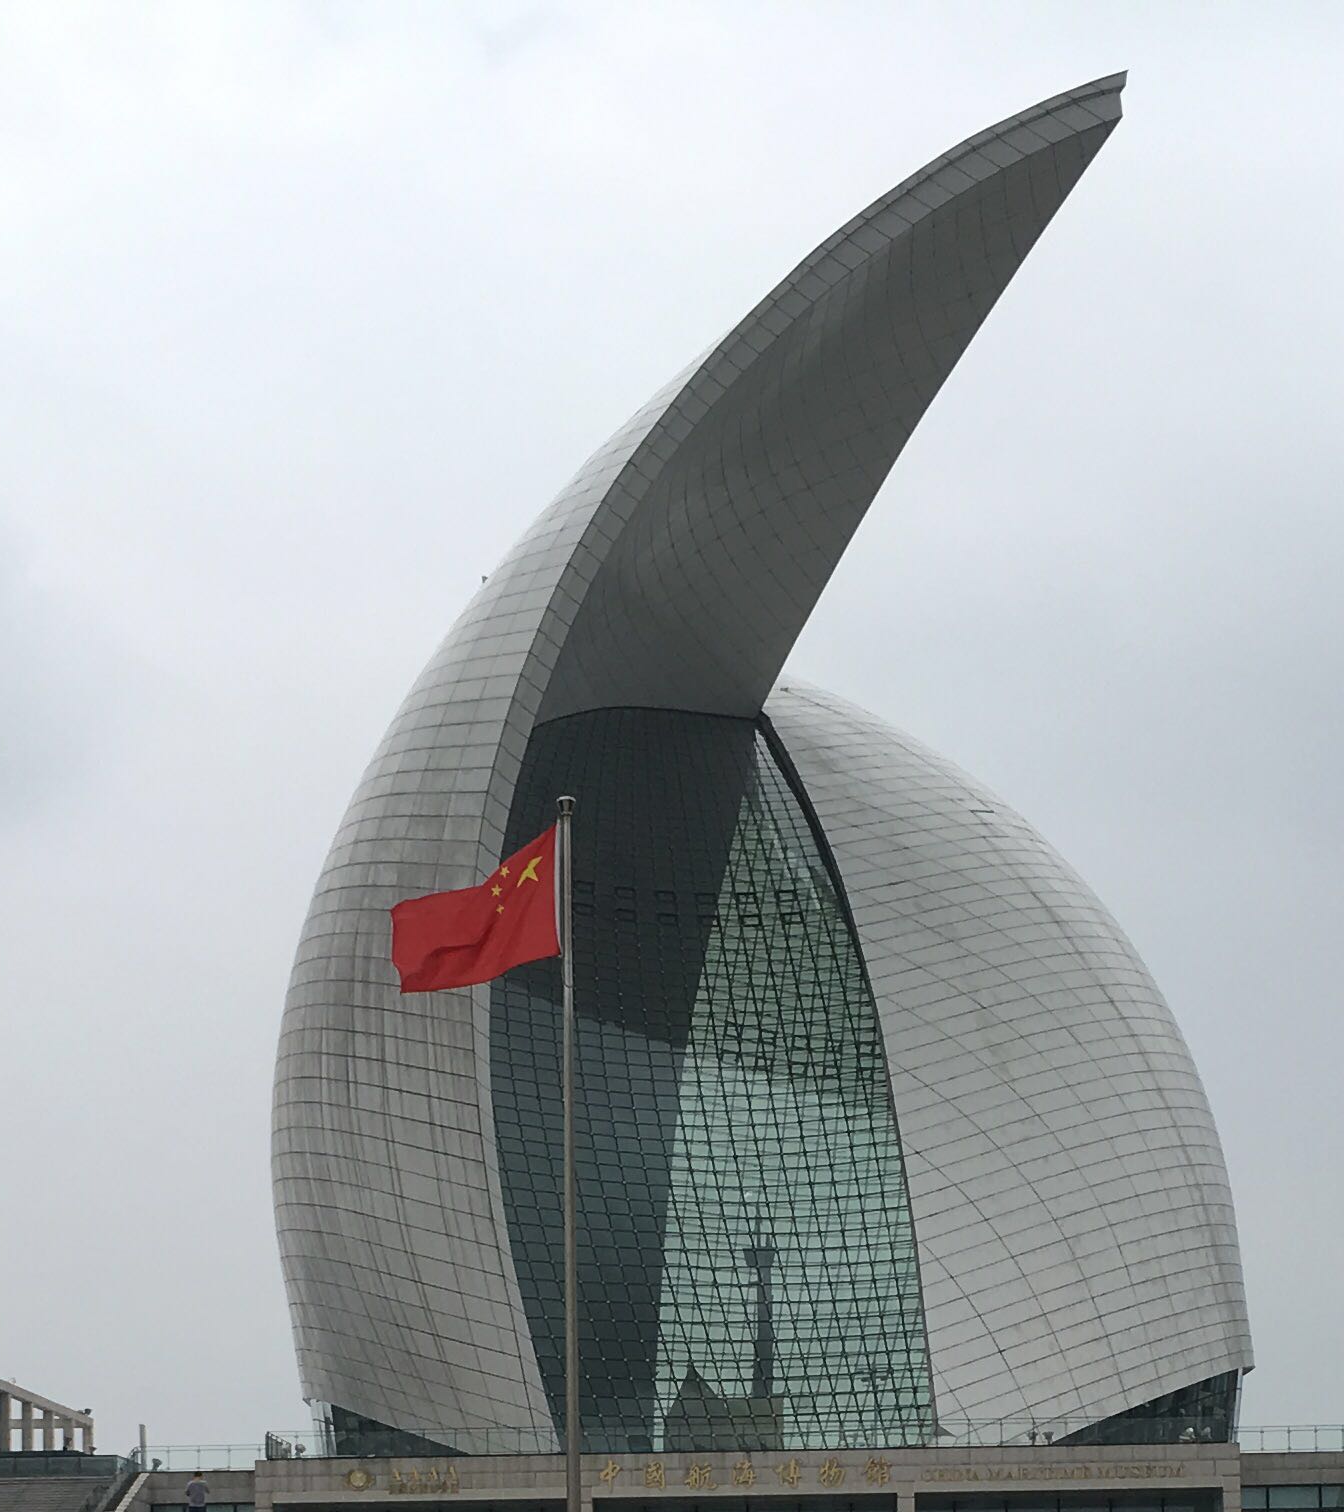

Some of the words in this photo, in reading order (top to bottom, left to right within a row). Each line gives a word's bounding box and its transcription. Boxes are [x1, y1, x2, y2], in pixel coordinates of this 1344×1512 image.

[599, 1455, 893, 1491] 中國航海博物館
